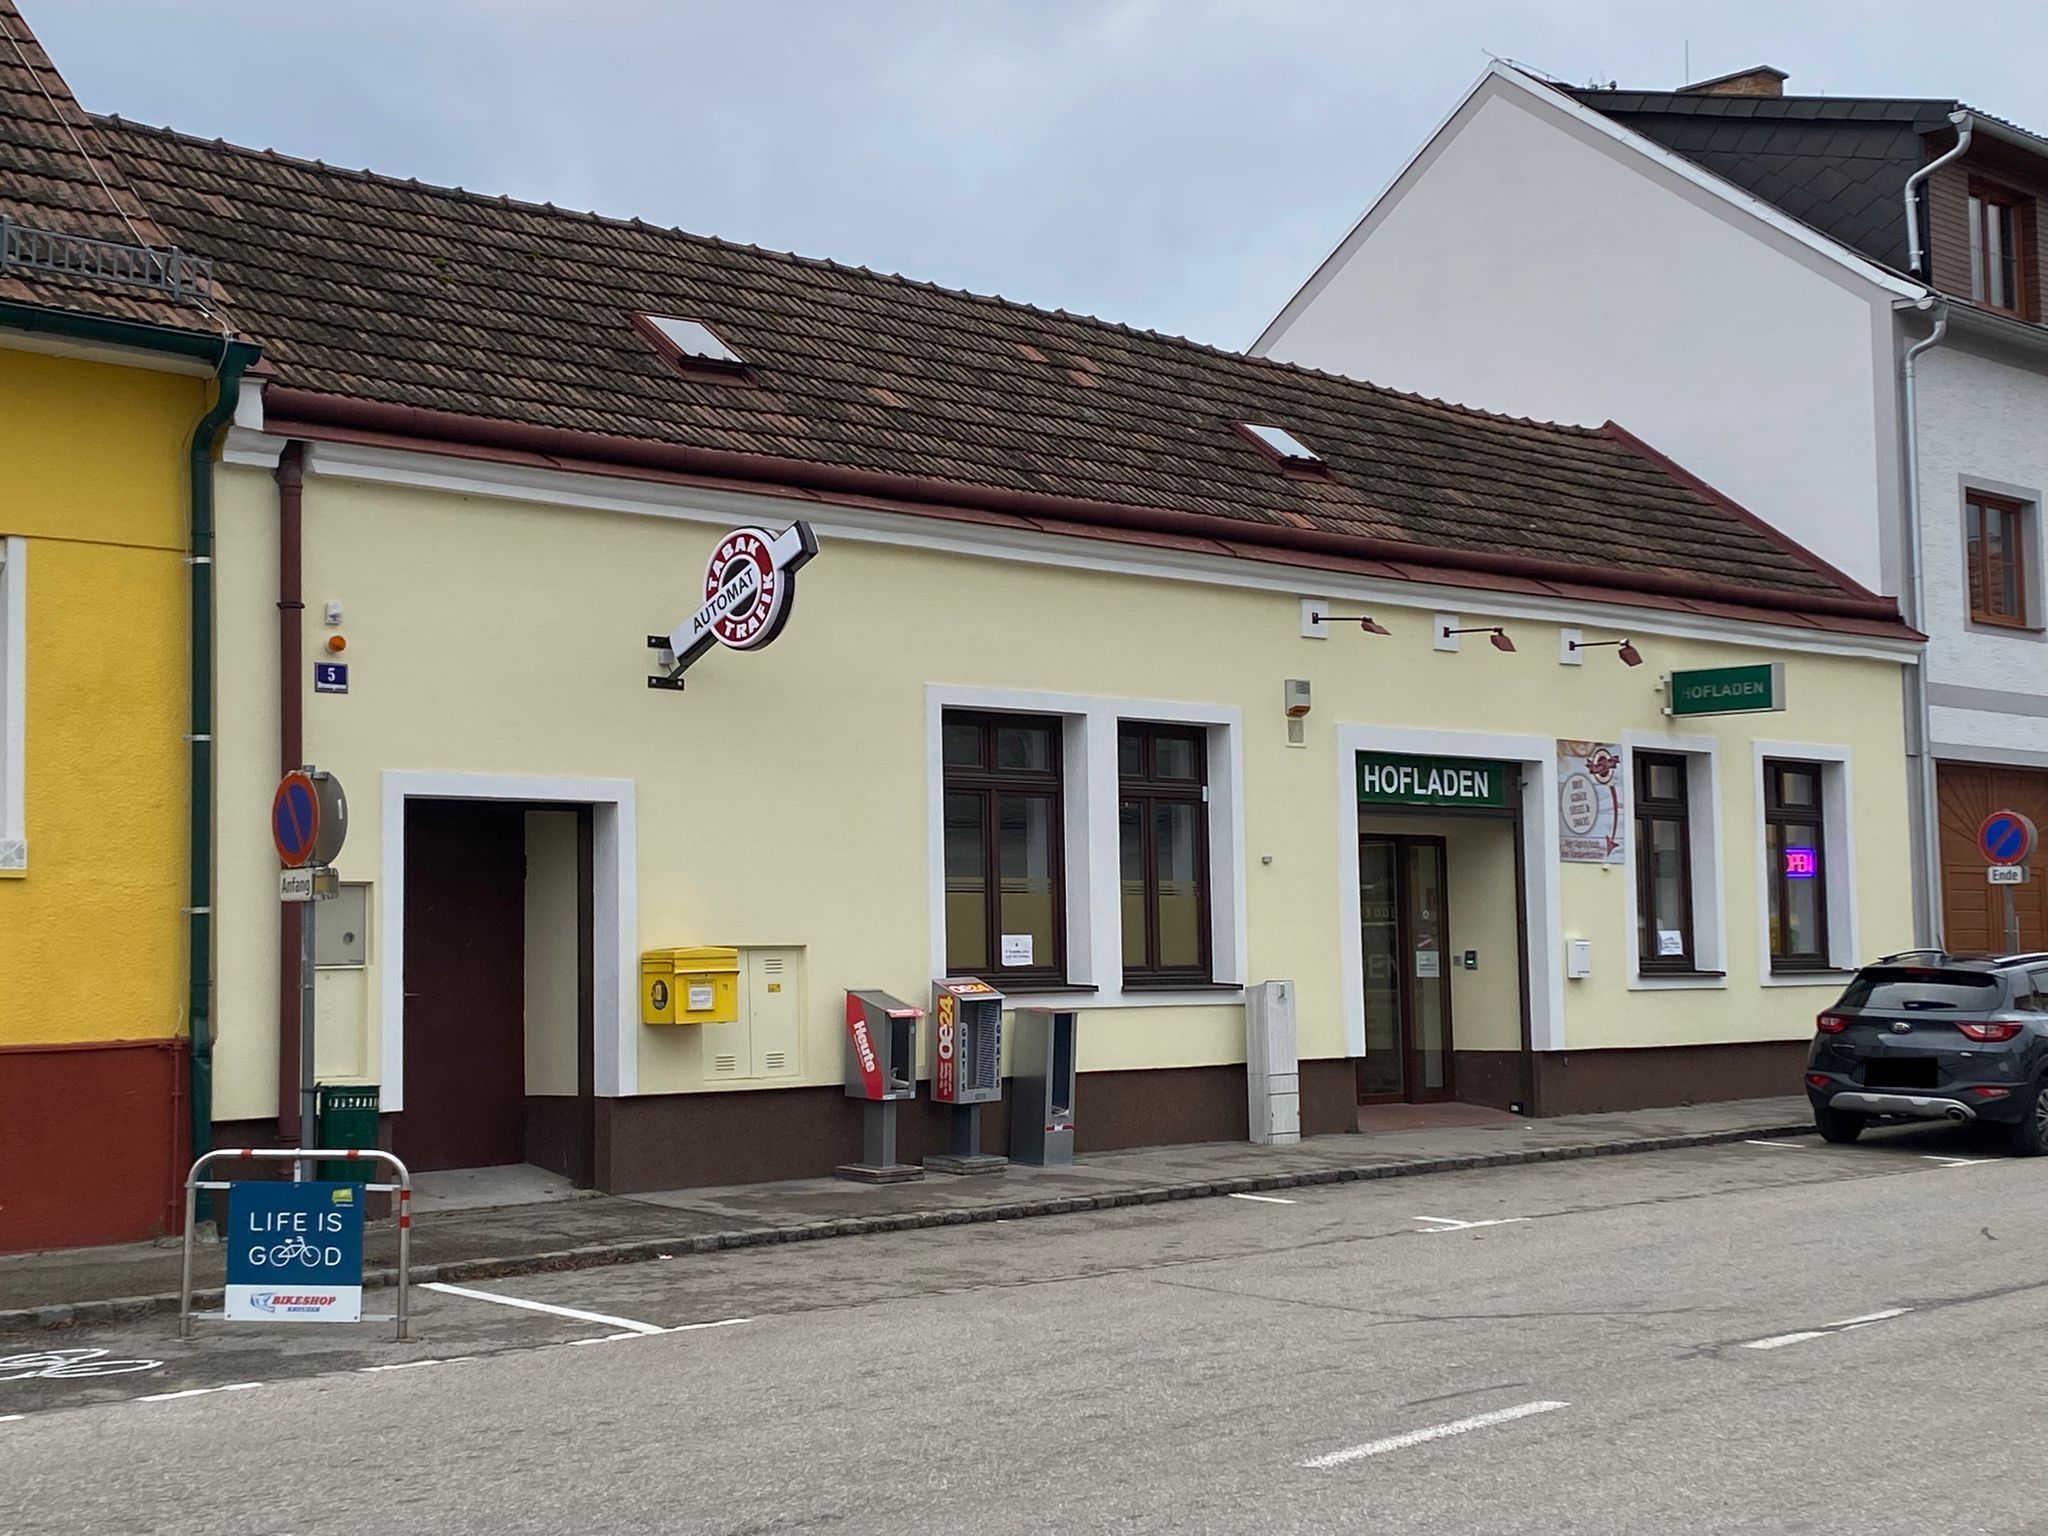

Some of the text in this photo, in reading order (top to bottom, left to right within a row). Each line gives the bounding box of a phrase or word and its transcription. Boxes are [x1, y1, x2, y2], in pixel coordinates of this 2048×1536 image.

[708, 536, 761, 591] TABAK
[693, 568, 756, 634] AUTOMAT
[723, 571, 774, 639] TRAFIK
[327, 667, 336, 682] 5
[1680, 681, 1764, 699] HOFLADEN
[1364, 764, 1489, 798] HOFLADEN
[1992, 869, 2018, 881] Ende
[281, 877, 311, 896] Anfang
[948, 983, 991, 994] oe24
[938, 995, 955, 1060] oe24
[853, 1019, 876, 1073] Heute
[249, 1211, 343, 1232] LIFE IS
[248, 1246, 342, 1268] GOOD
[271, 1295, 337, 1306] BIKESHOP
